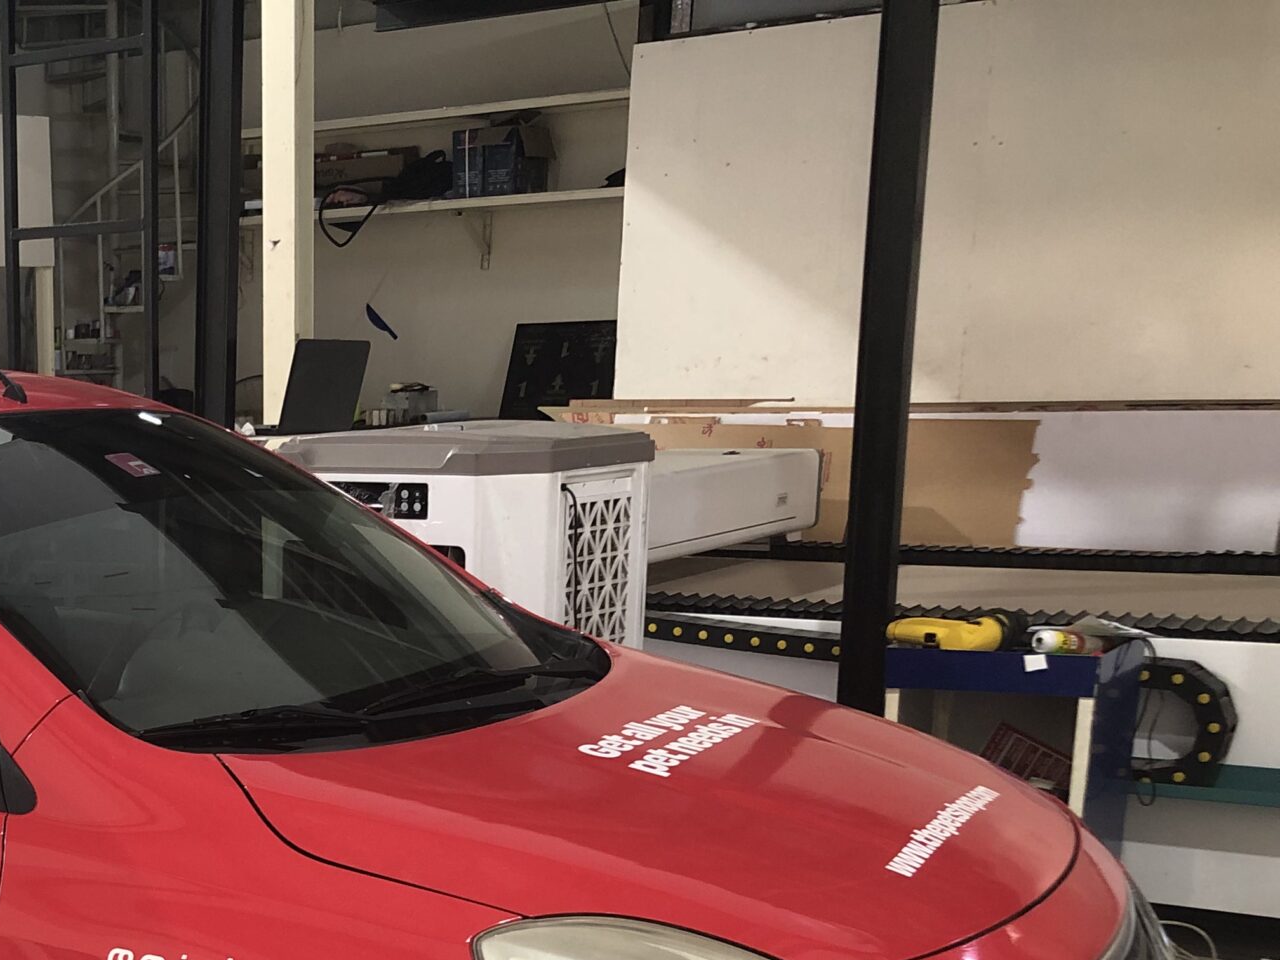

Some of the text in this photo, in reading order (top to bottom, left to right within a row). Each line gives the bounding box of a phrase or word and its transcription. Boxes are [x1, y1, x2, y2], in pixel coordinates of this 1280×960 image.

[577, 705, 707, 758] Get all your
[628, 713, 761, 778] pet needs in
